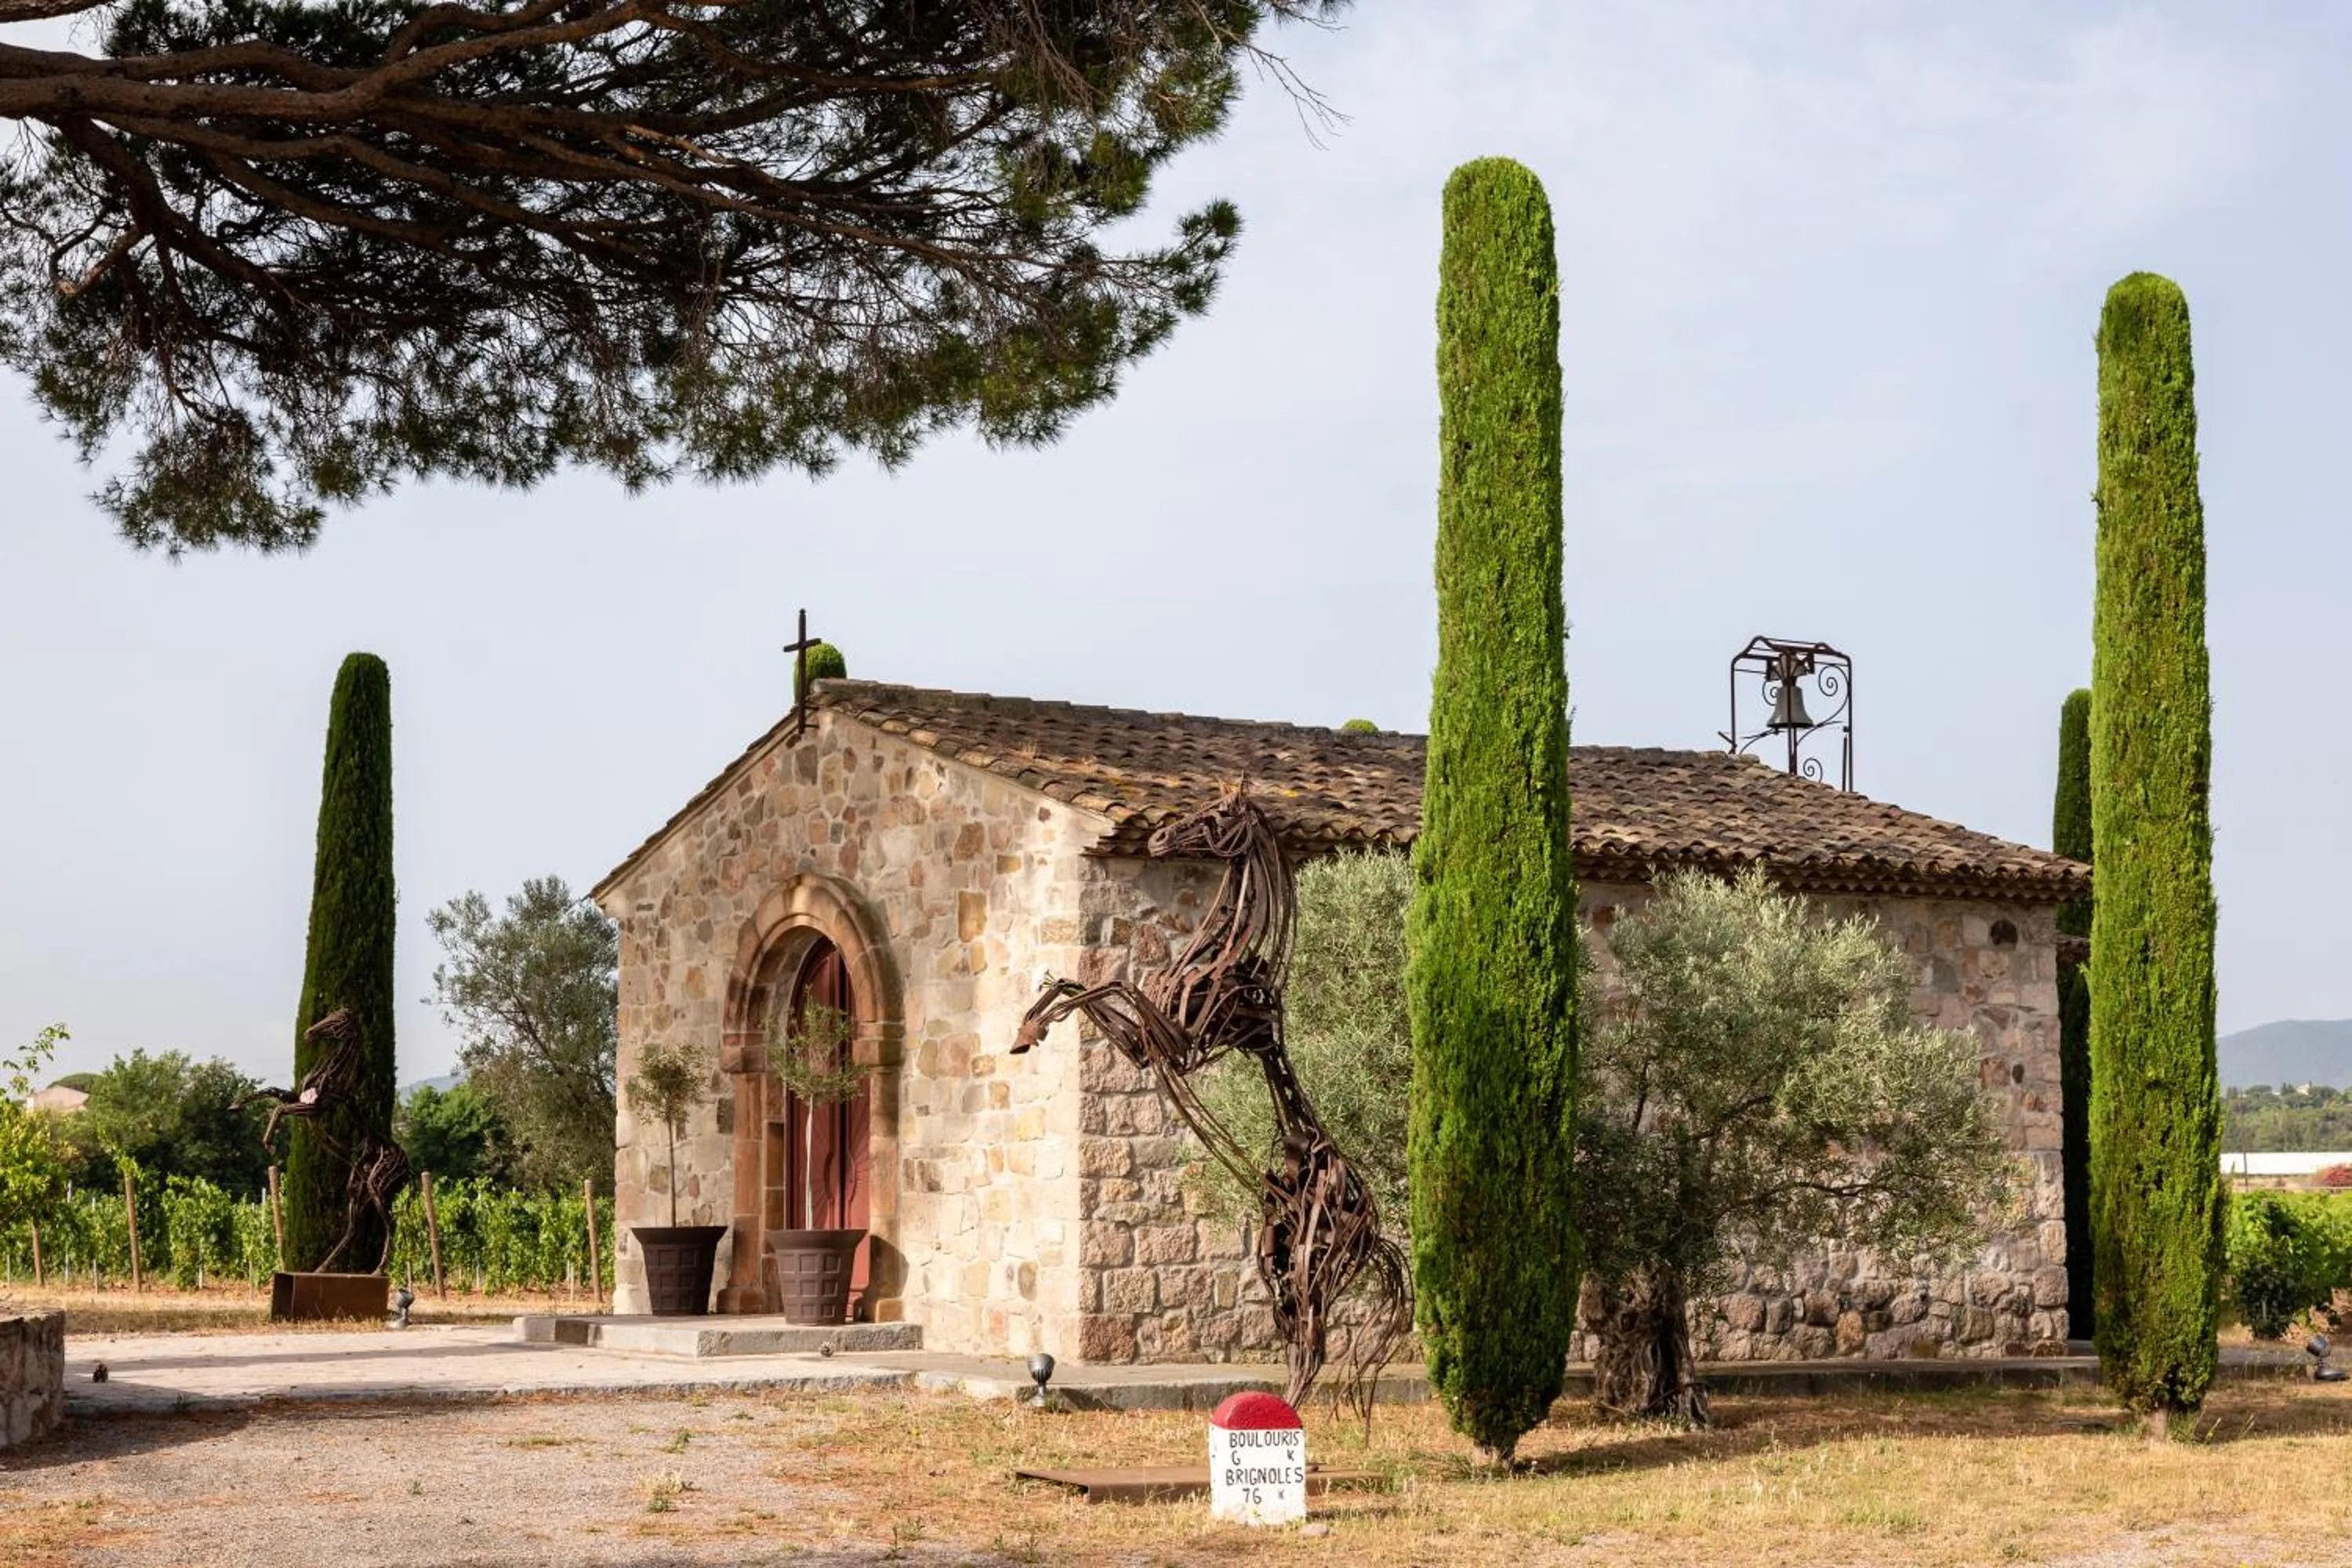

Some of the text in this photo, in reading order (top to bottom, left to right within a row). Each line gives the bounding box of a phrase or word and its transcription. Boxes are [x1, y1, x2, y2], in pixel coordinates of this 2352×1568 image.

[1229, 1431, 1300, 1448] BOULOURIS
[1287, 1449, 1295, 1461] K
[1225, 1467, 1304, 1486] BRIGNOLES
[1243, 1487, 1262, 1504] 76
